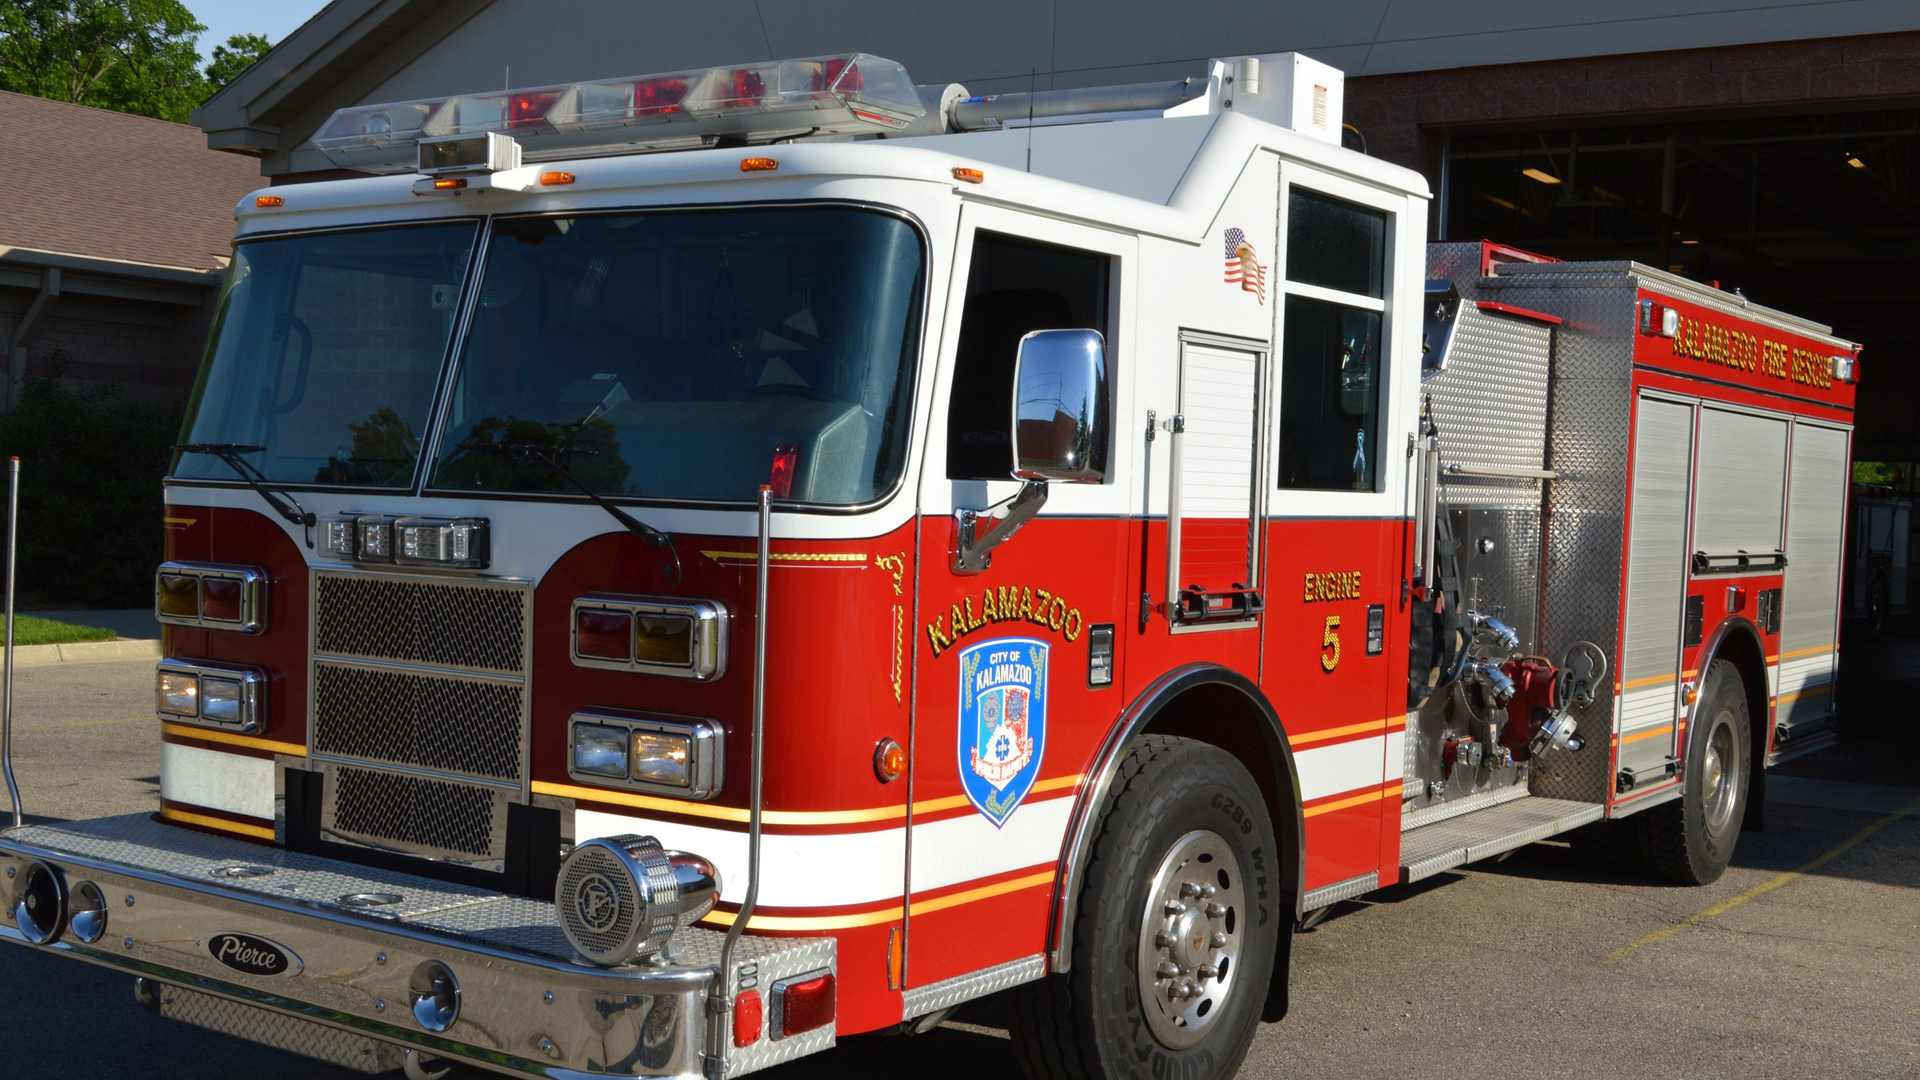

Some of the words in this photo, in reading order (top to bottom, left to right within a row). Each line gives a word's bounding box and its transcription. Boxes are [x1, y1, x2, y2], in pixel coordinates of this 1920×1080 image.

[1673, 315, 1757, 373] KALAMAZOO
[1761, 339, 1788, 379] FIRE
[1791, 347, 1832, 389] RESCUE
[1304, 571, 1361, 603] ENGINE
[927, 585, 1082, 659] KALAMAZOO
[1320, 615, 1340, 674] 5
[976, 664, 1032, 692] KALAMAZOO
[989, 652, 1007, 664] CITY
[1010, 651, 1021, 662] OF
[1211, 793, 1253, 835] G289
[1251, 846, 1268, 928] WHA
[218, 935, 277, 969] Pierce
